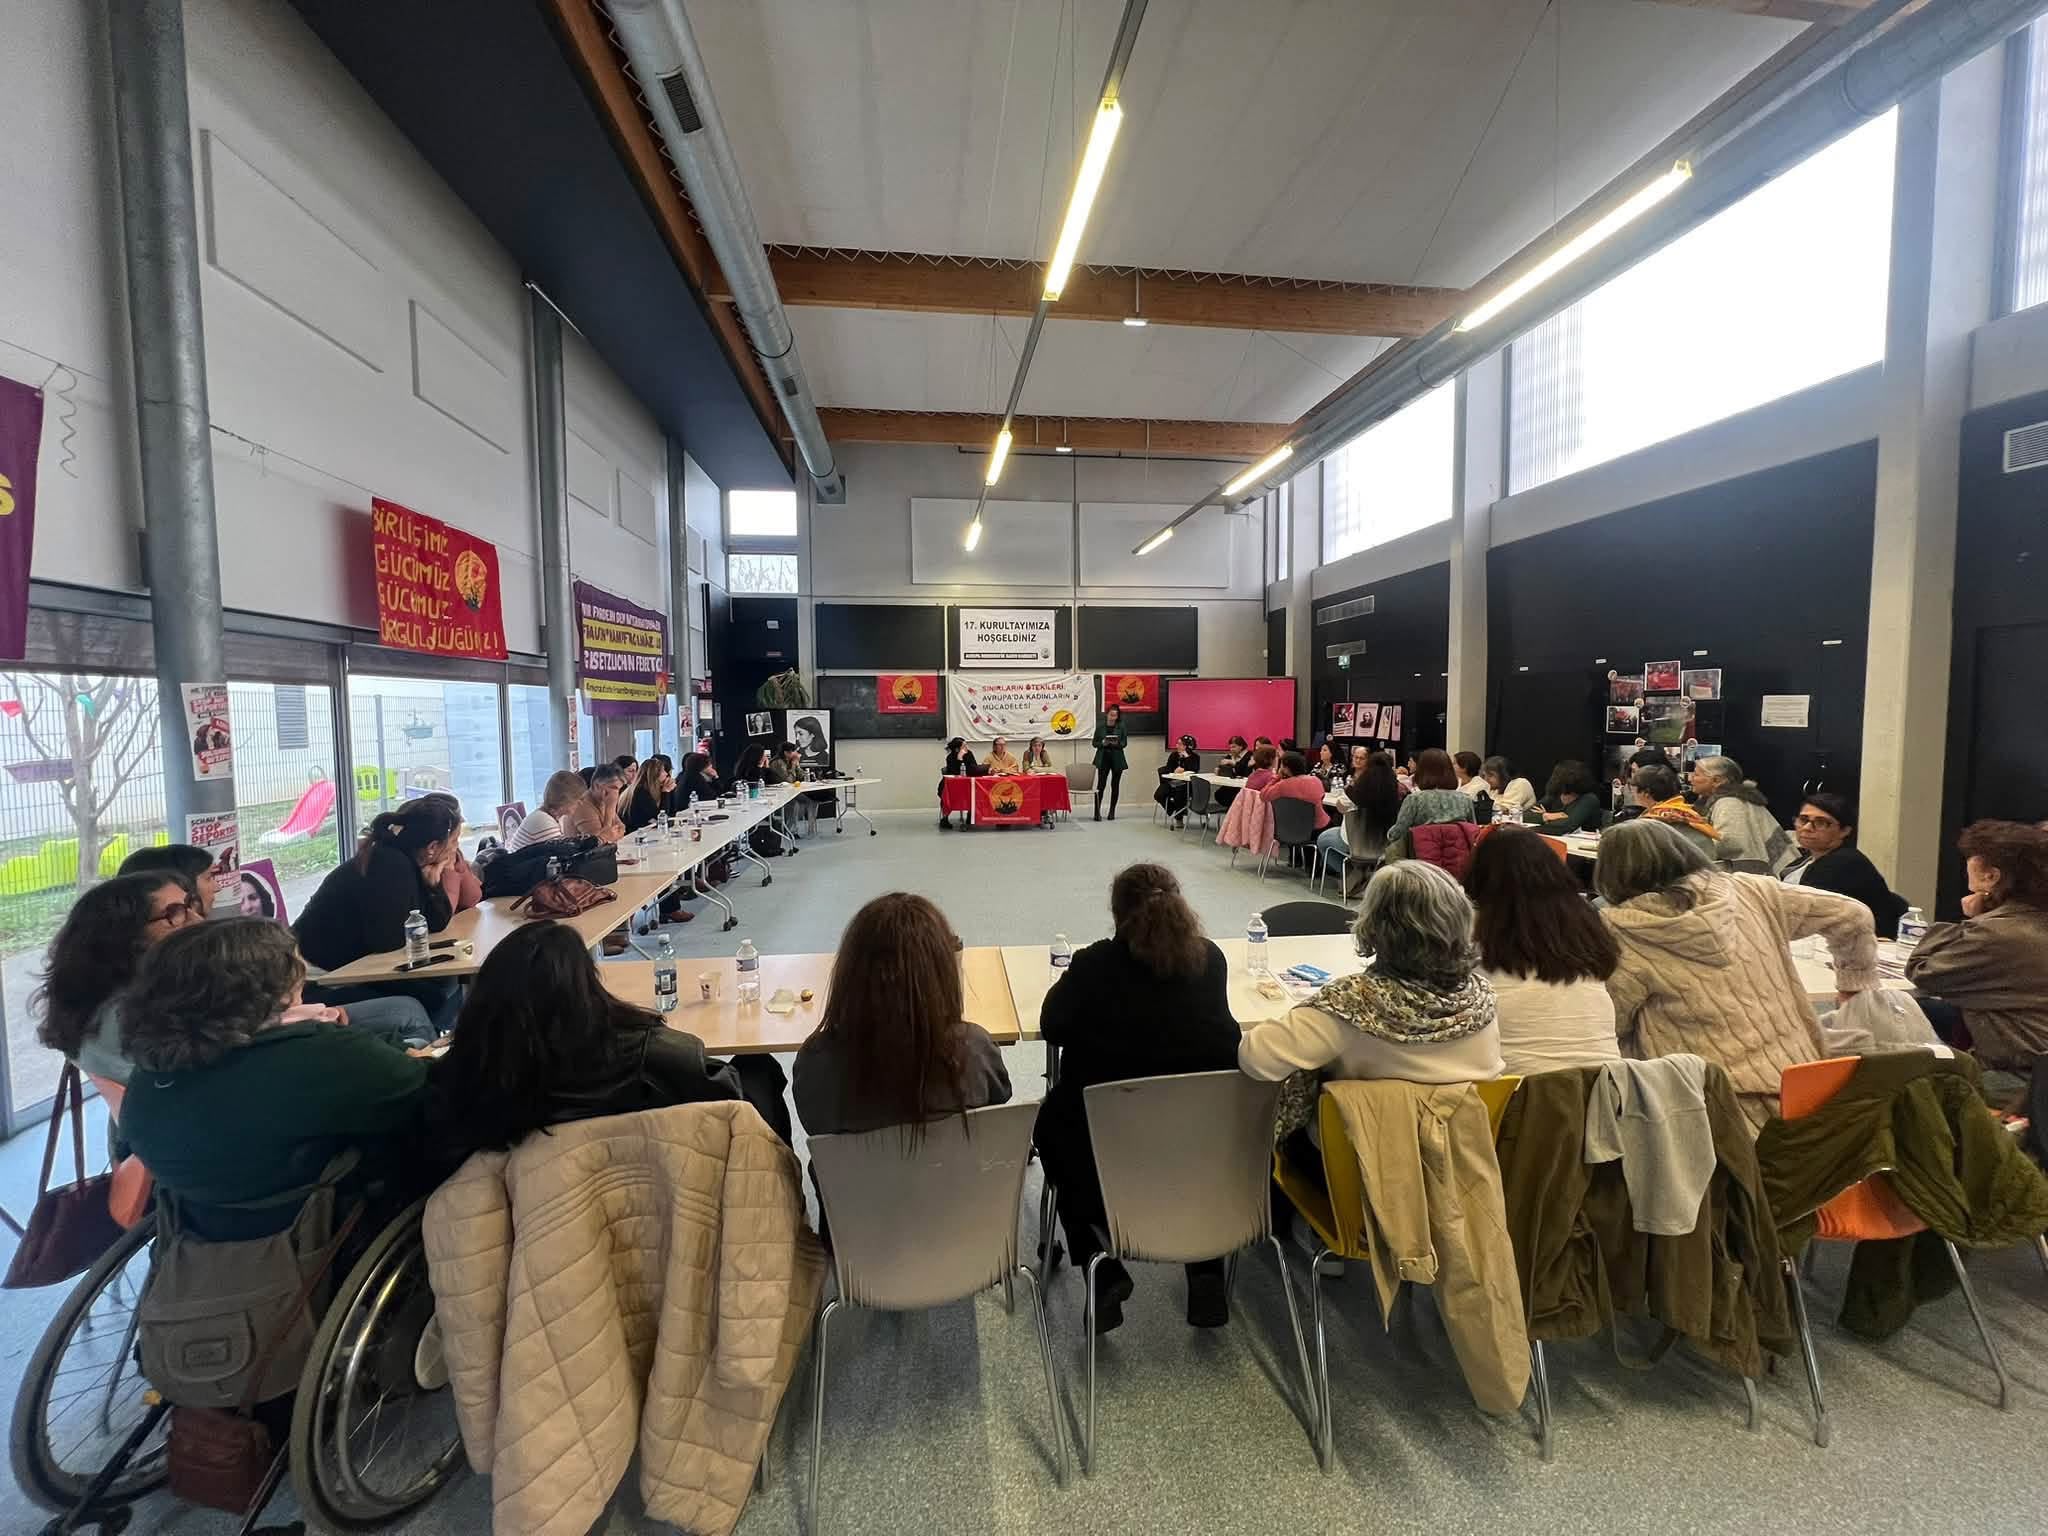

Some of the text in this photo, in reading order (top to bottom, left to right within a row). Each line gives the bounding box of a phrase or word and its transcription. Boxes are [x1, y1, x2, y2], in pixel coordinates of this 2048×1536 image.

[964, 621, 1050, 630] 17. KURULTAYIMIZA
[977, 632, 1037, 644] HOŞGELDİNİZ
[1026, 693, 1071, 701] KADINLARIN
